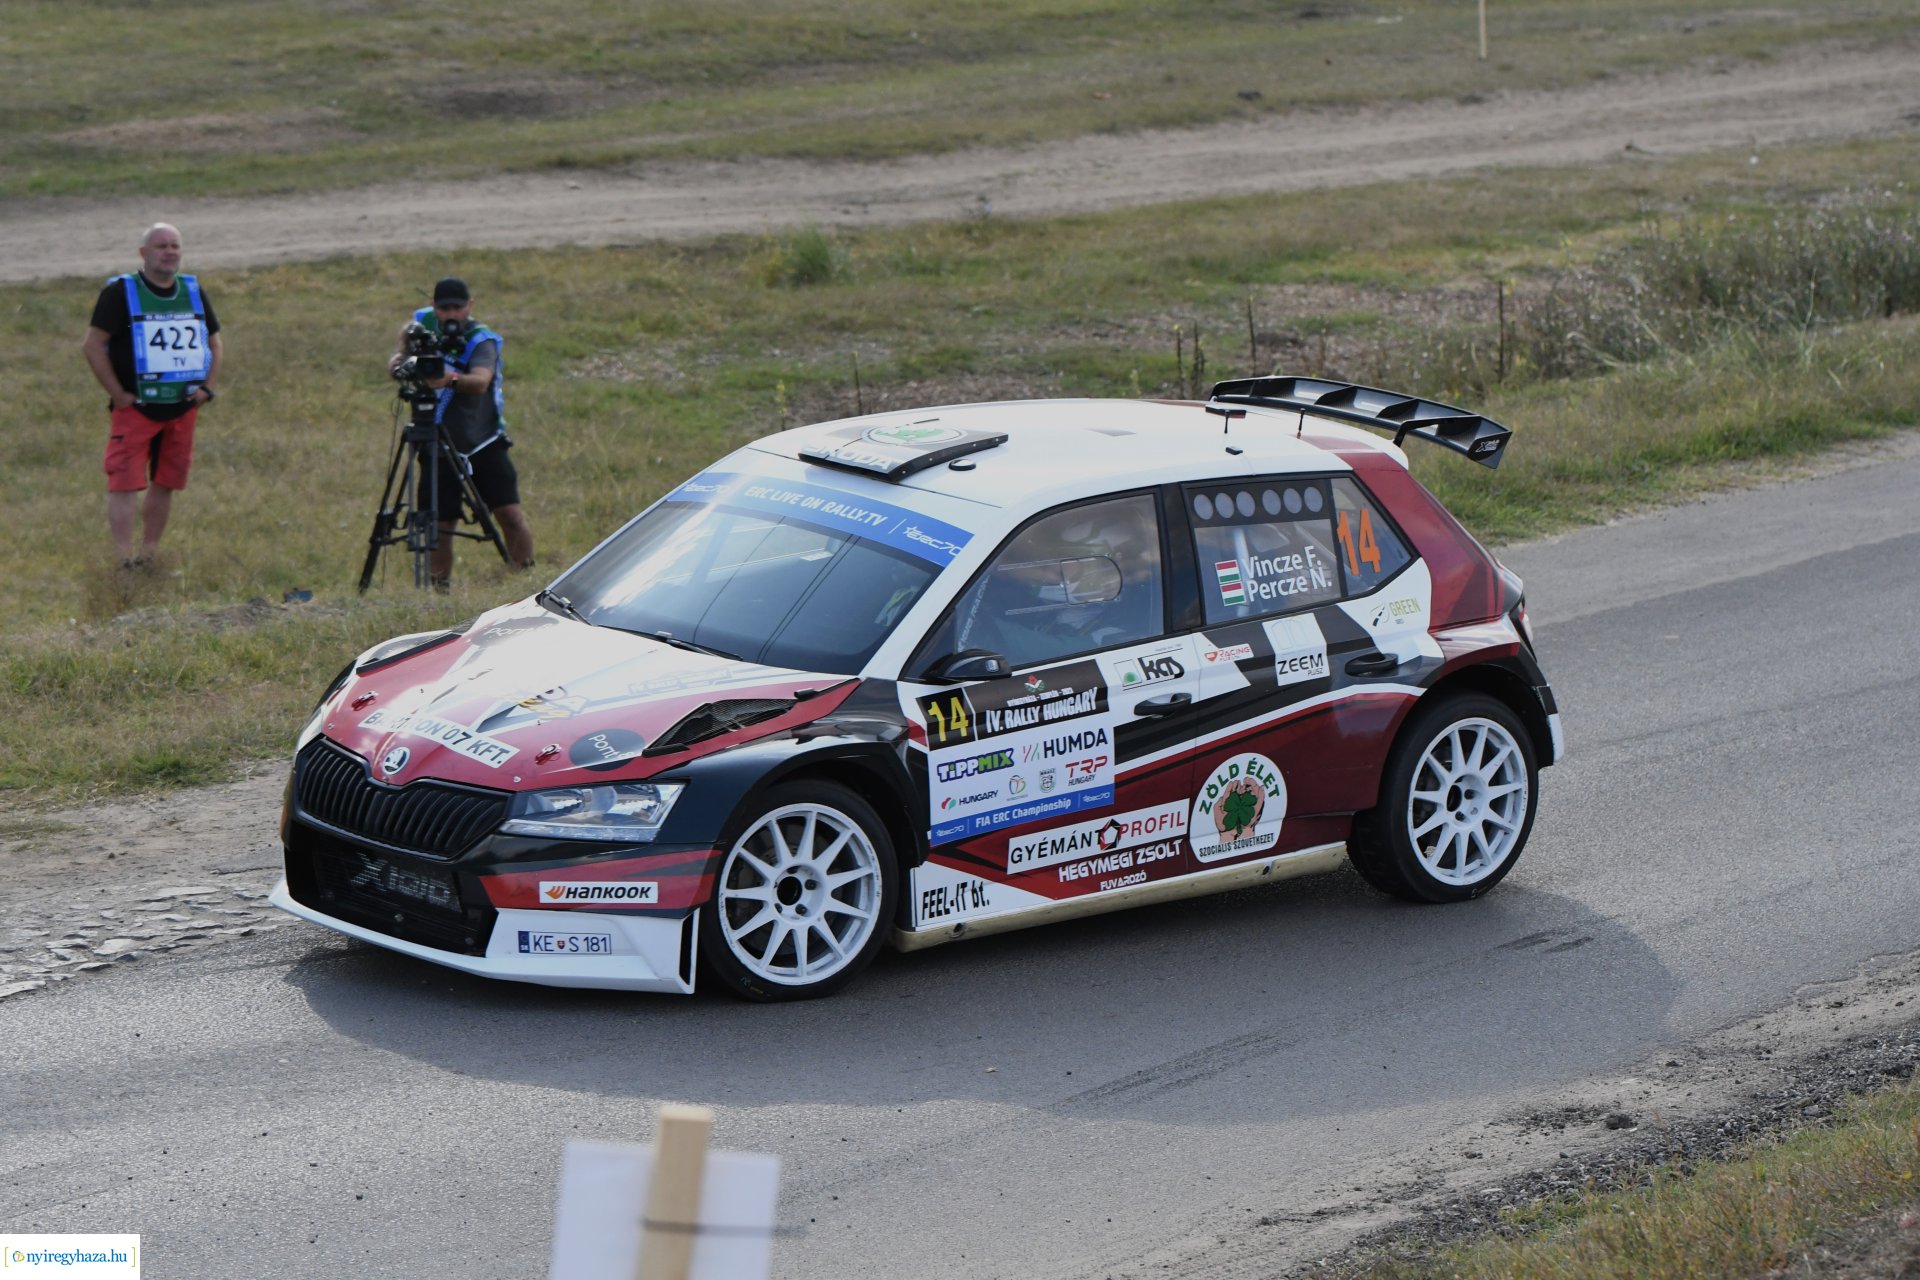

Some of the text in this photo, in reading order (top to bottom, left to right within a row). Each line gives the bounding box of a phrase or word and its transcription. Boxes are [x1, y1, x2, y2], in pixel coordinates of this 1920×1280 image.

[149, 326, 198, 351] 422
[173, 357, 186, 367] TV
[744, 486, 888, 527] ERC LIVE ON RALLY.TV
[1336, 508, 1382, 576] 14
[1247, 545, 1322, 579] Vincze F.
[1246, 566, 1333, 602] Percze N.
[1388, 597, 1421, 617] GREEN
[1277, 653, 1323, 675] ZEEM
[928, 696, 969, 742] 14
[986, 709, 1003, 734] IV.
[1004, 705, 1041, 730] RALLY
[1043, 686, 1098, 720] HUNGARY
[465, 738, 511, 765] KFT.
[1043, 728, 1108, 758] HUMDA
[1065, 755, 1108, 779] TRP
[1067, 773, 1096, 786] HUNGARY
[958, 789, 999, 806] HUNGARY
[1198, 757, 1280, 815] ZÖLD ÉLET
[975, 815, 991, 828] FIA
[992, 811, 1011, 824] ERC
[1011, 797, 1072, 820] Championship
[1010, 810, 1186, 864] GYÉMÁNT PROFIL
[1058, 838, 1183, 883] HEGYMEGI ZSOLT
[1100, 871, 1147, 891] FUVAROZÓ
[921, 879, 990, 921] FEEL-IT bt.
[533, 934, 608, 953] KE S 181
